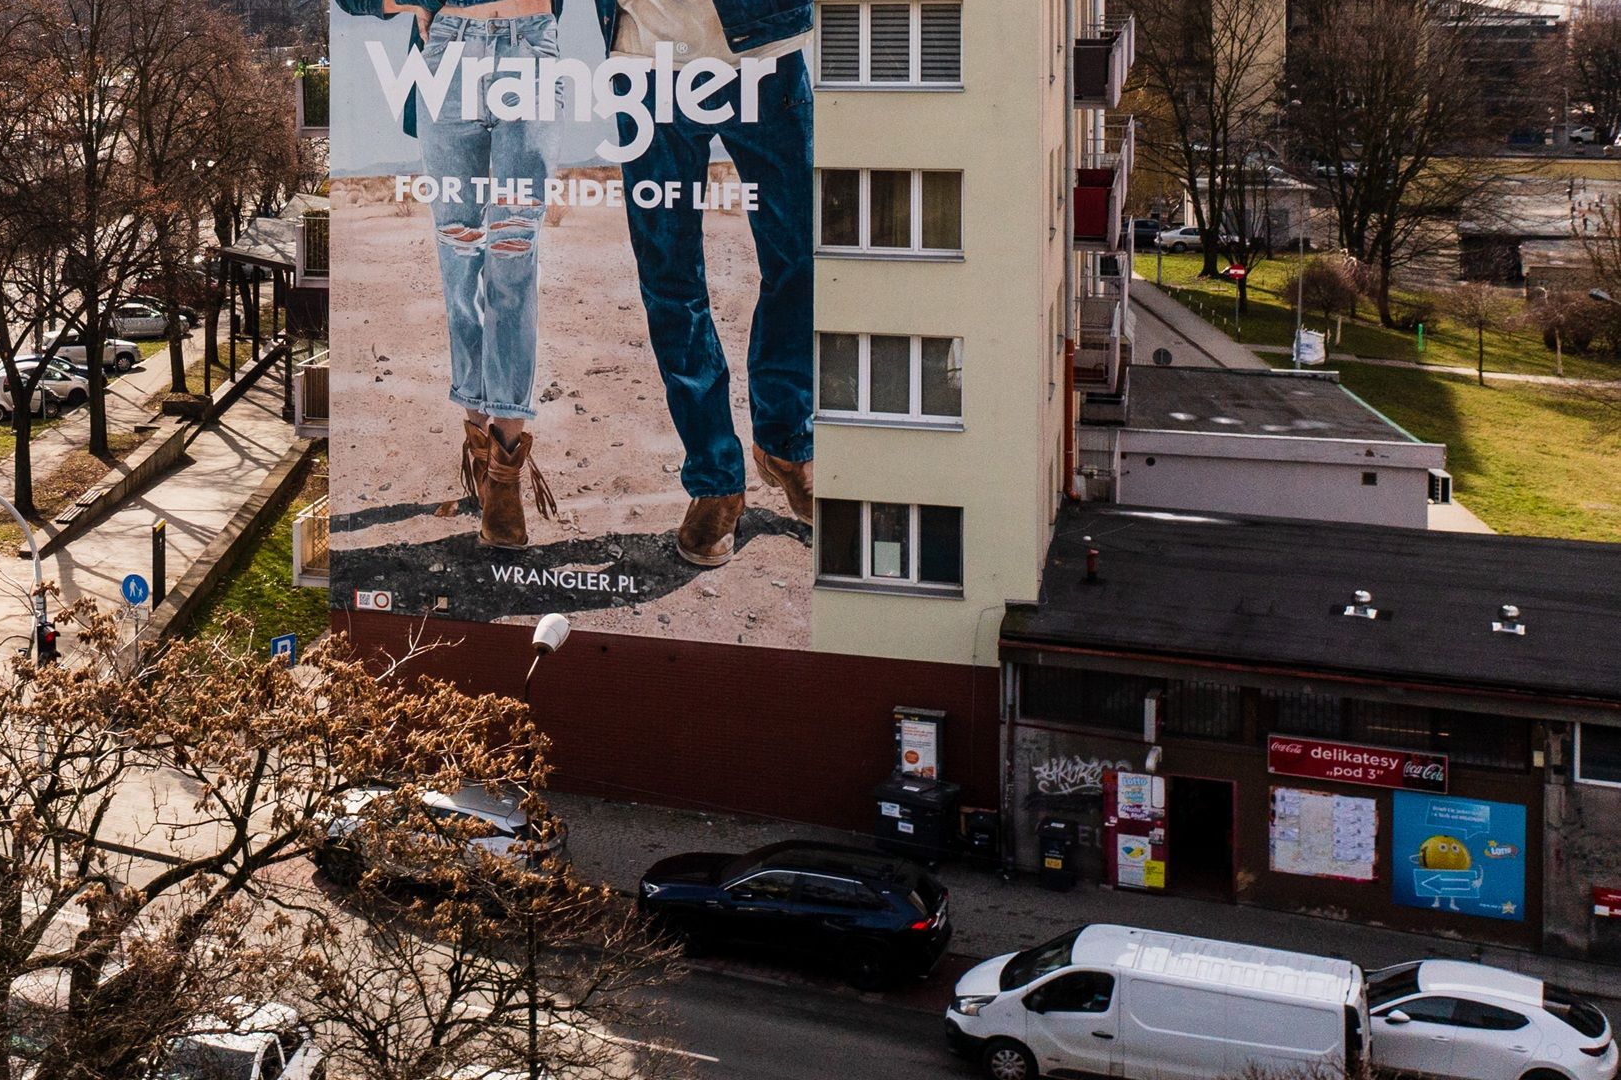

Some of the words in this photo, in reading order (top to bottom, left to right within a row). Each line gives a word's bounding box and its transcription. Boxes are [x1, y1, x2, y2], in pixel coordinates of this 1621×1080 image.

[364, 40, 777, 164] Wrangler
[395, 175, 464, 204] FOR
[470, 176, 533, 206] THE
[544, 178, 624, 209] RIDE
[631, 180, 681, 210] OF
[692, 181, 759, 212] LIFE
[491, 564, 639, 594] WRANGLER.PL
[1310, 746, 1399, 770] delikatesy
[1403, 760, 1445, 782] Coca-Cola
